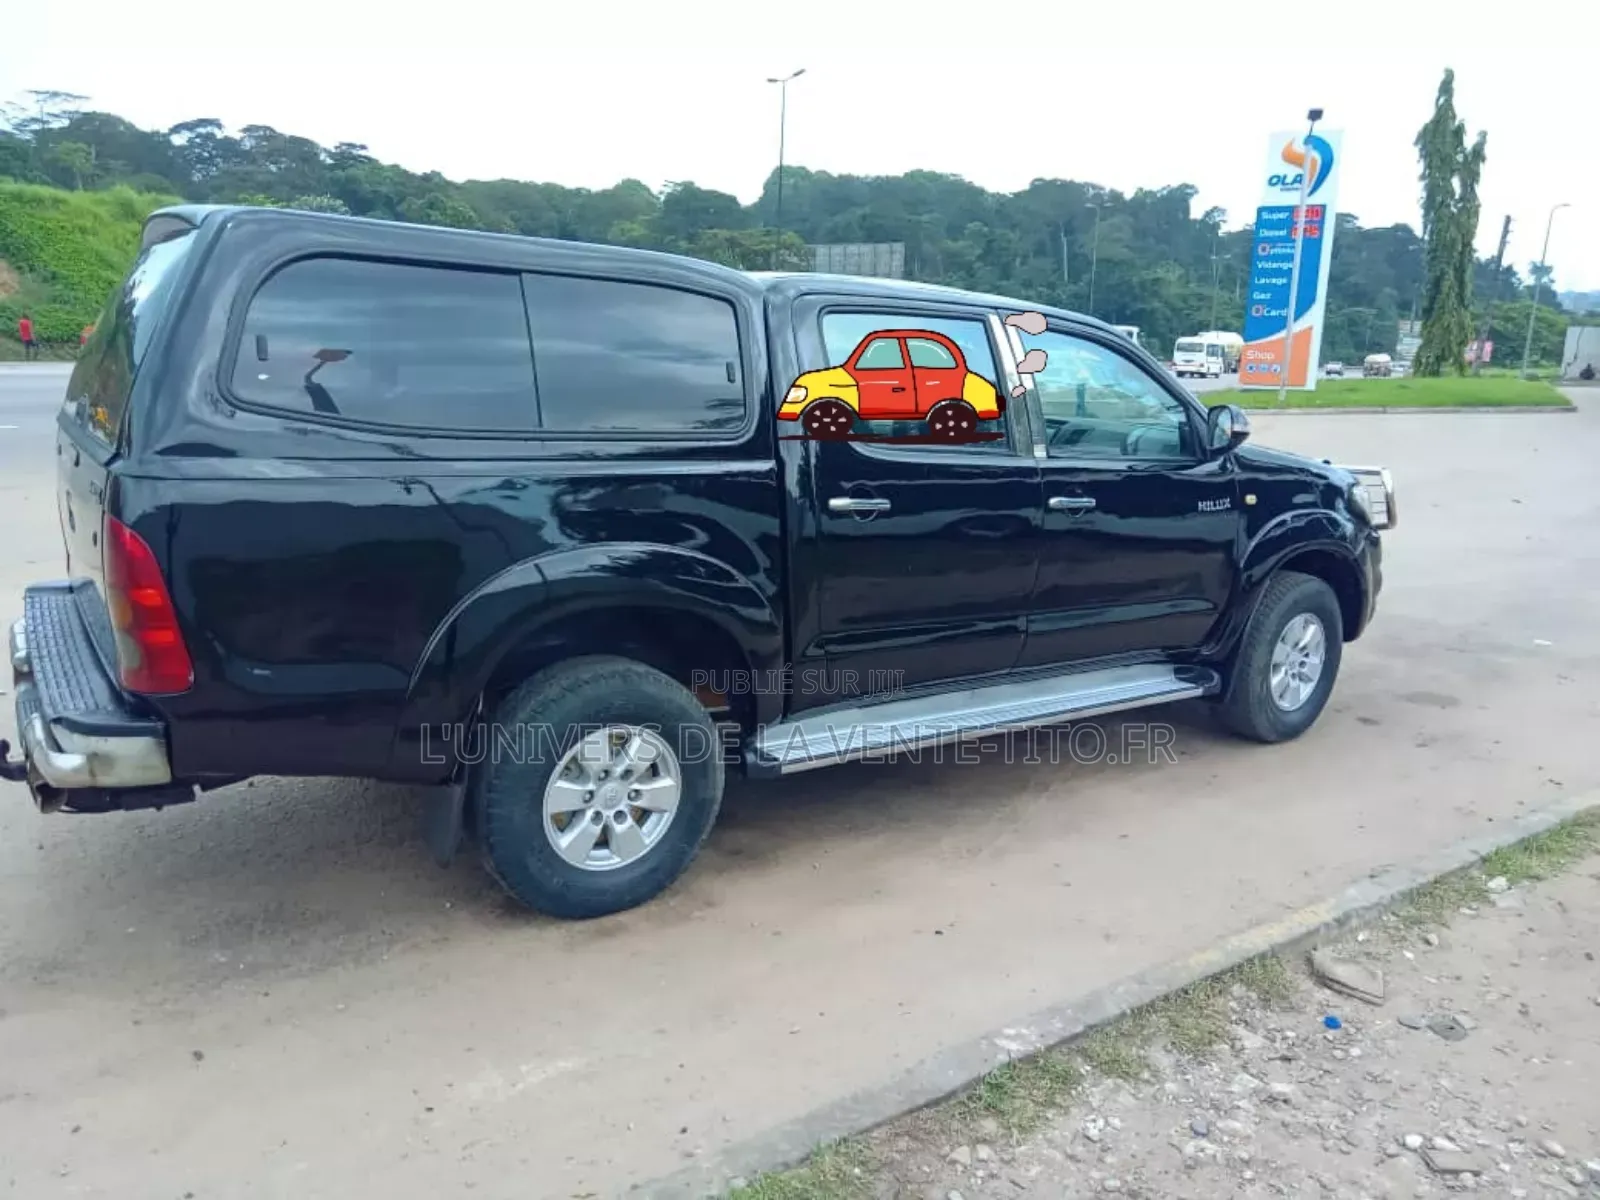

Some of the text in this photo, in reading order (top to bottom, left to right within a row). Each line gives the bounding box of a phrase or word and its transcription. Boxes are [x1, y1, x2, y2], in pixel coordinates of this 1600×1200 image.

[1267, 173, 1304, 187] OLA
[1261, 210, 1290, 221] Super
[1254, 276, 1288, 286] Lavage
[1252, 291, 1272, 300] Gaz
[1246, 349, 1276, 361] Shop
[1197, 496, 1232, 512] HILUX
